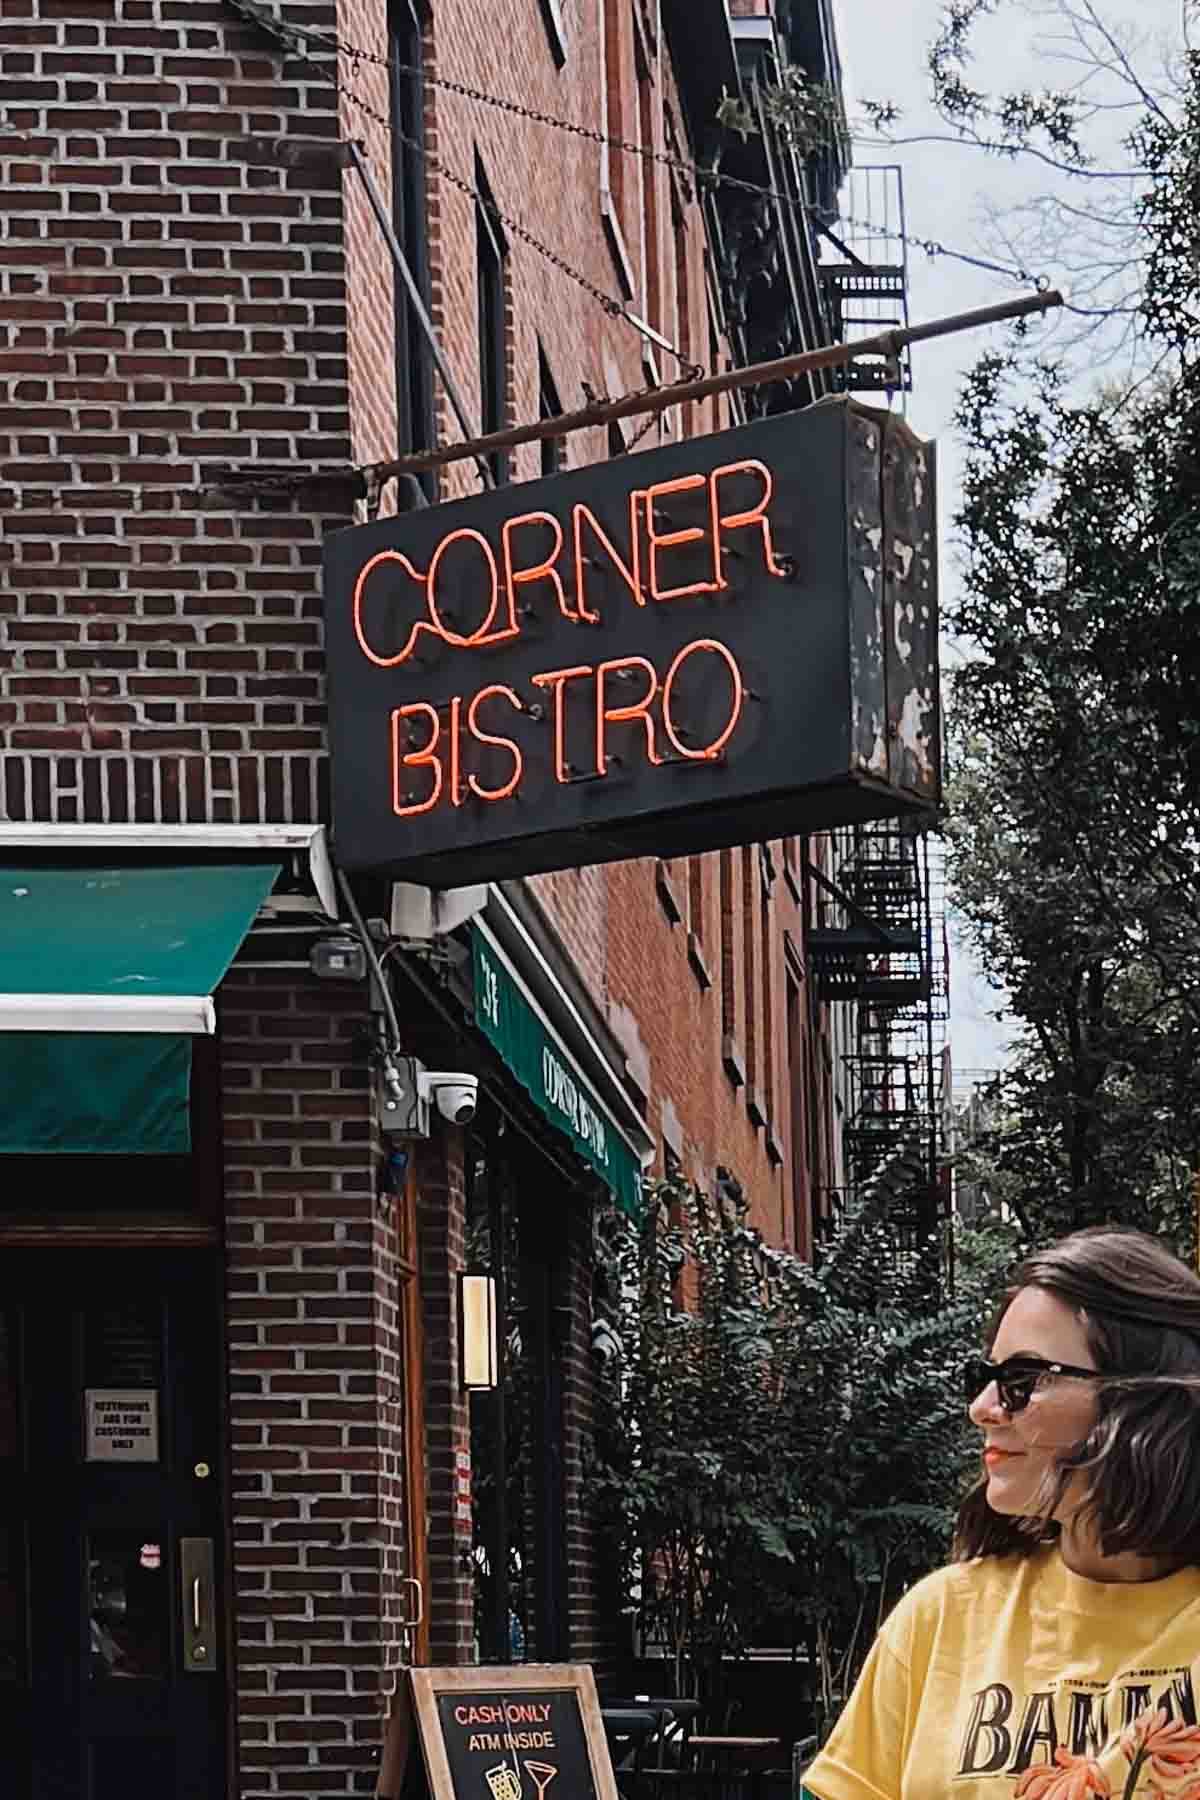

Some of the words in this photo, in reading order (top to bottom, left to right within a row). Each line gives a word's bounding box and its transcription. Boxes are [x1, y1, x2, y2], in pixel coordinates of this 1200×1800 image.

[353, 459, 796, 667] CORNER
[391, 638, 742, 816] BISTRO
[455, 1705, 504, 1725] CASH
[505, 1704, 551, 1723] ONLY
[469, 1734, 500, 1751] ATM
[503, 1731, 556, 1749] INSIDE
